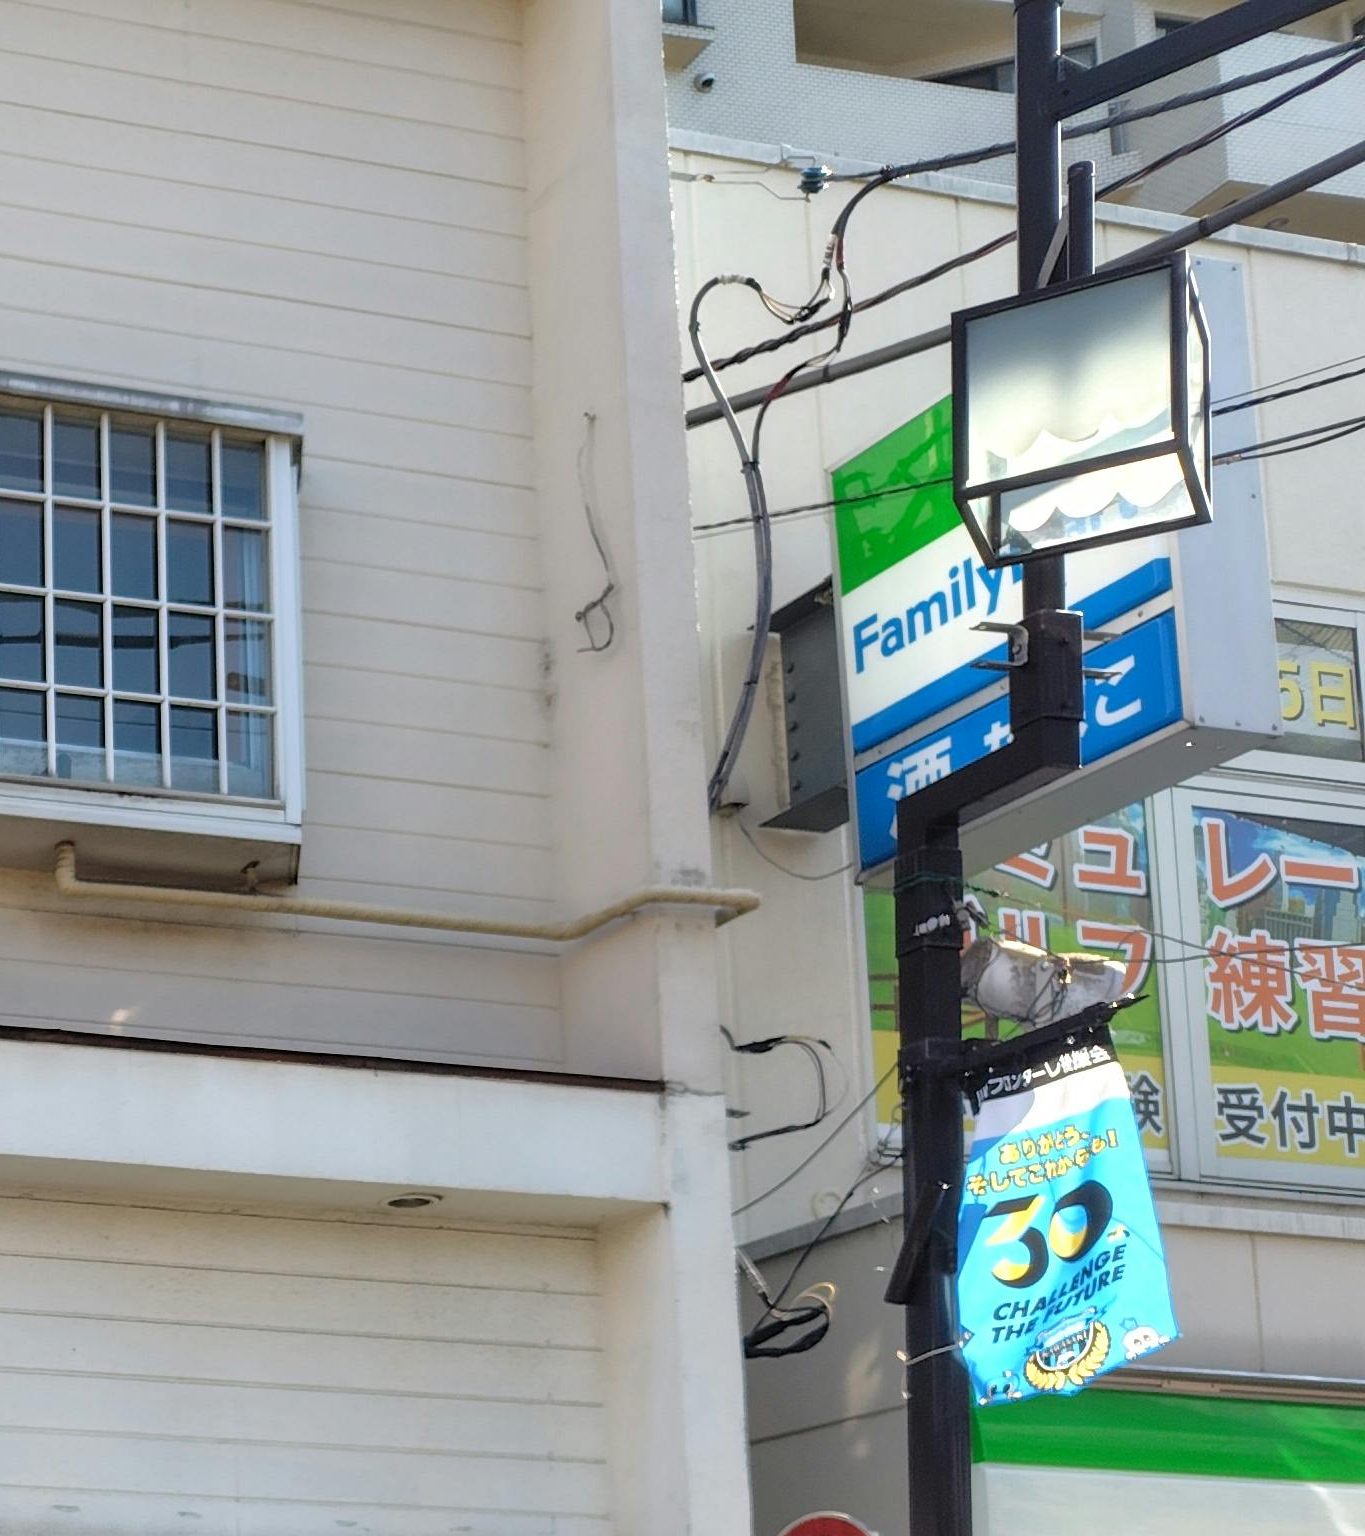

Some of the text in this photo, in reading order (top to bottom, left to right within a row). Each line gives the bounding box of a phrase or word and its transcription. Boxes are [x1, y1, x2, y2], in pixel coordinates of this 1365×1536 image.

[983, 1179, 1114, 1289] 30
[991, 1263, 1127, 1344] THE FUTURE
[992, 1244, 1128, 1322] CHALLENGE
